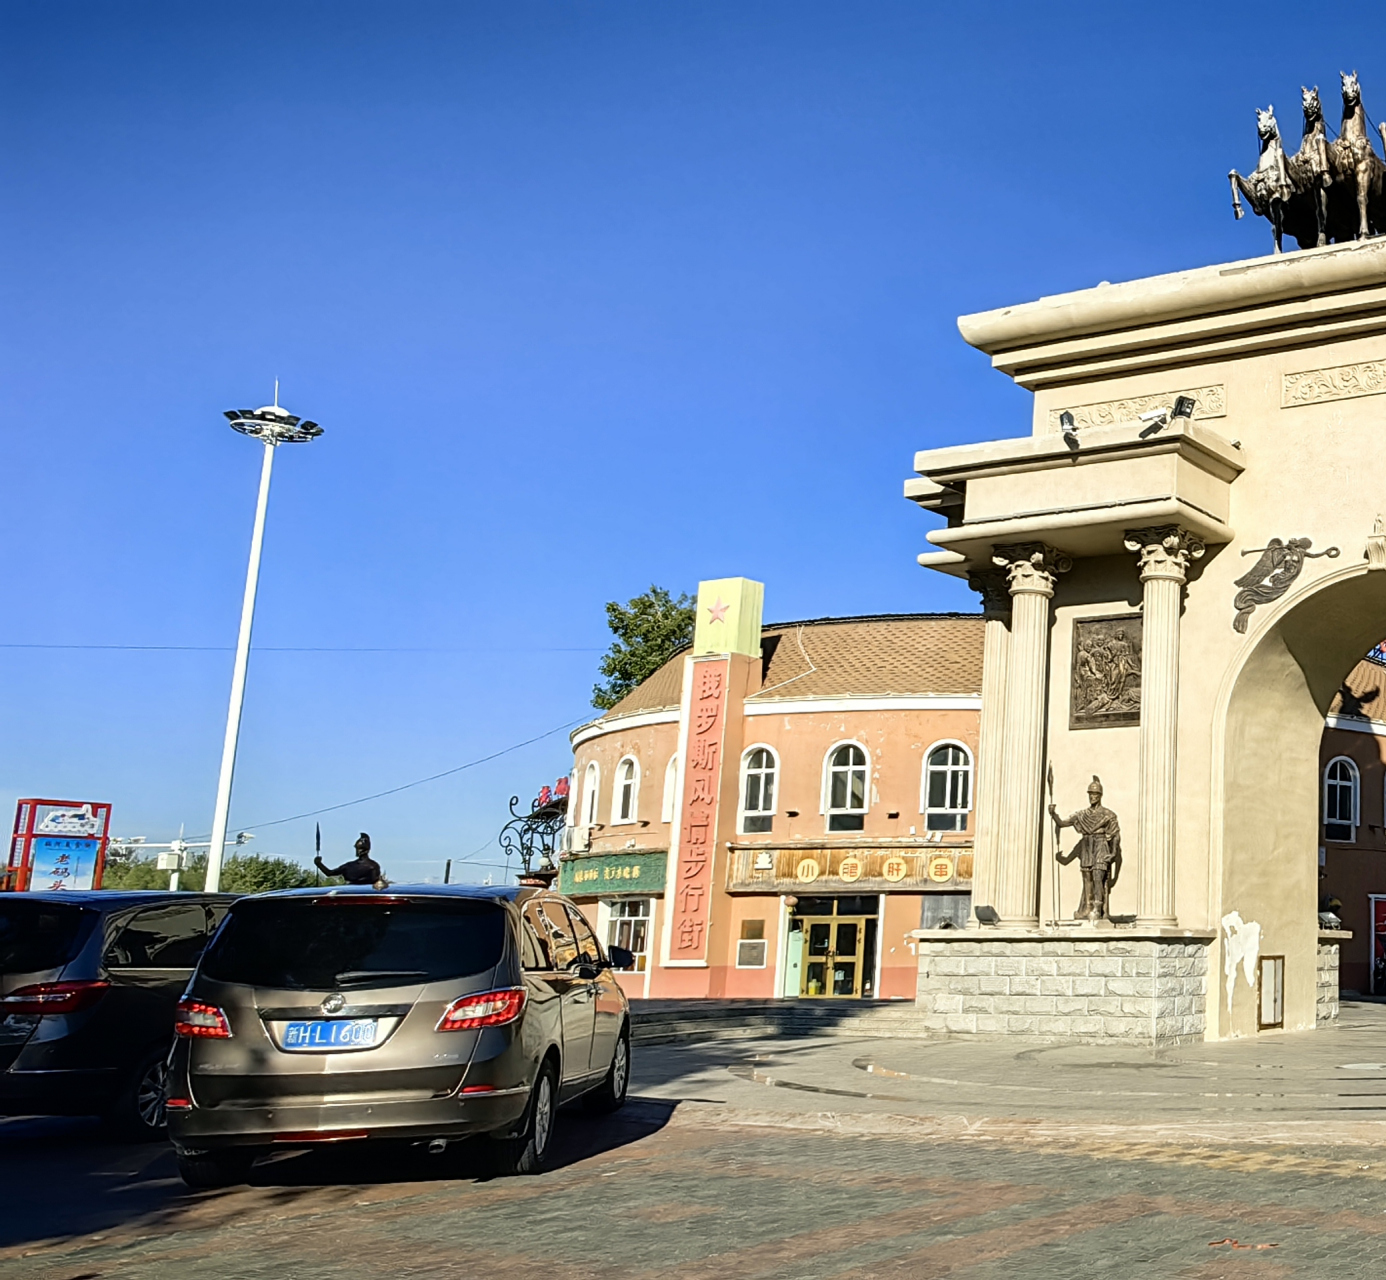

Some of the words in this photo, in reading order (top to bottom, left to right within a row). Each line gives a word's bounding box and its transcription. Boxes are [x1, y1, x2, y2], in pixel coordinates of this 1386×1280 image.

[47, 853, 71, 891] 老码头
[677, 667, 721, 950] 俄罗斯风情步行街
